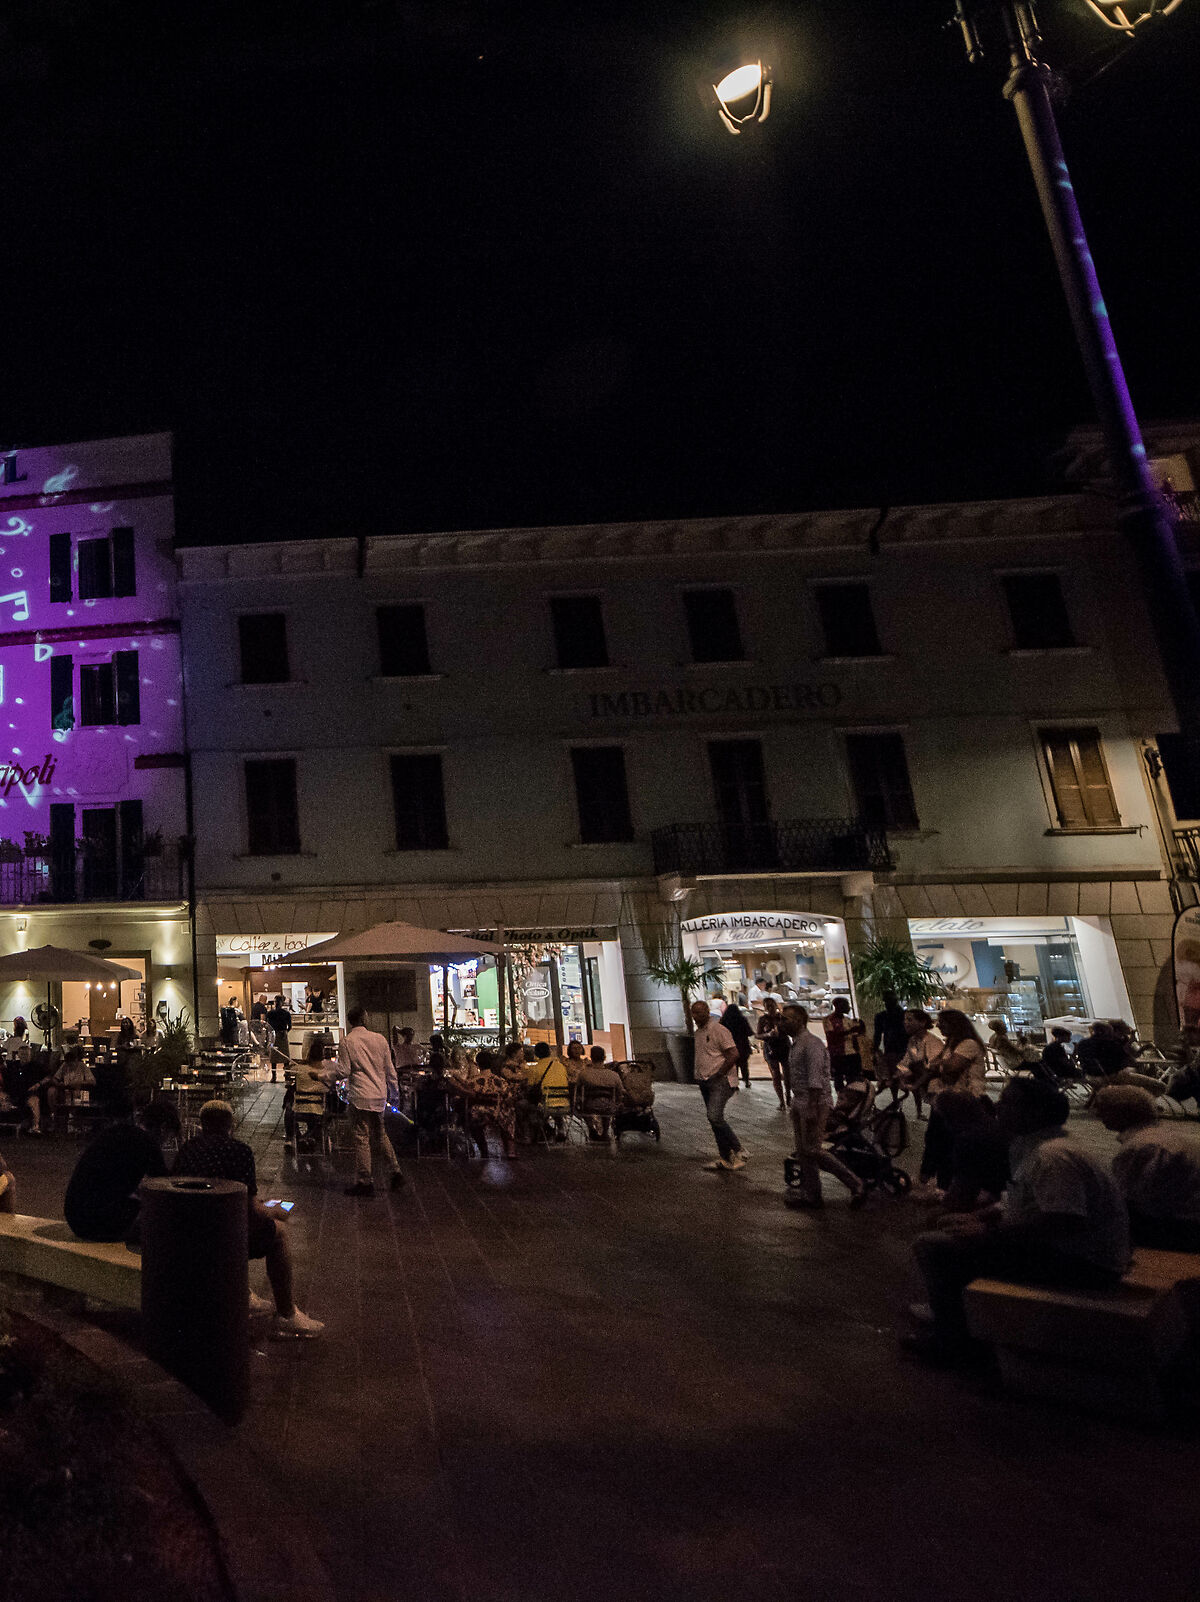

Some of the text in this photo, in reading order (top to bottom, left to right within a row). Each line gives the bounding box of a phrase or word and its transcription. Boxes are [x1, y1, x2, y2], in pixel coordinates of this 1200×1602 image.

[588, 683, 842, 718] IMBARCADERO
[680, 916, 818, 933] ALLERIA IMBARCADERO
[230, 935, 270, 951] Coffee
[272, 941, 281, 950] &
[284, 934, 308, 950] Food
[544, 932, 553, 940] &
[557, 927, 600, 941] Optik
